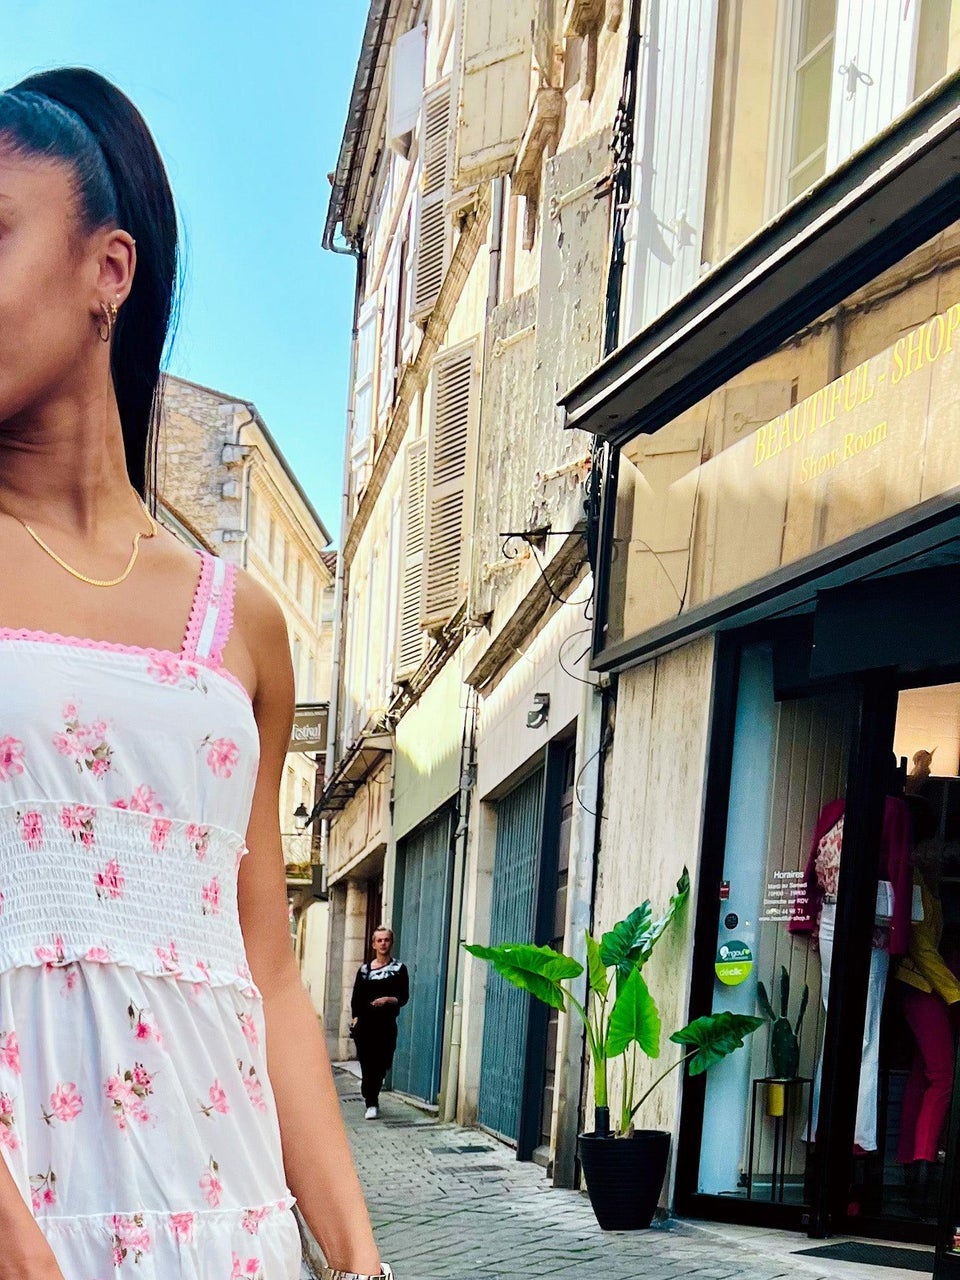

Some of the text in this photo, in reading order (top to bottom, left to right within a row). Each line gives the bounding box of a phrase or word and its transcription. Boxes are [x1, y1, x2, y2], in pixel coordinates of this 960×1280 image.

[891, 303, 960, 384] SHOP
[801, 422, 888, 484] Show Room
[773, 870, 805, 879] Horaires
